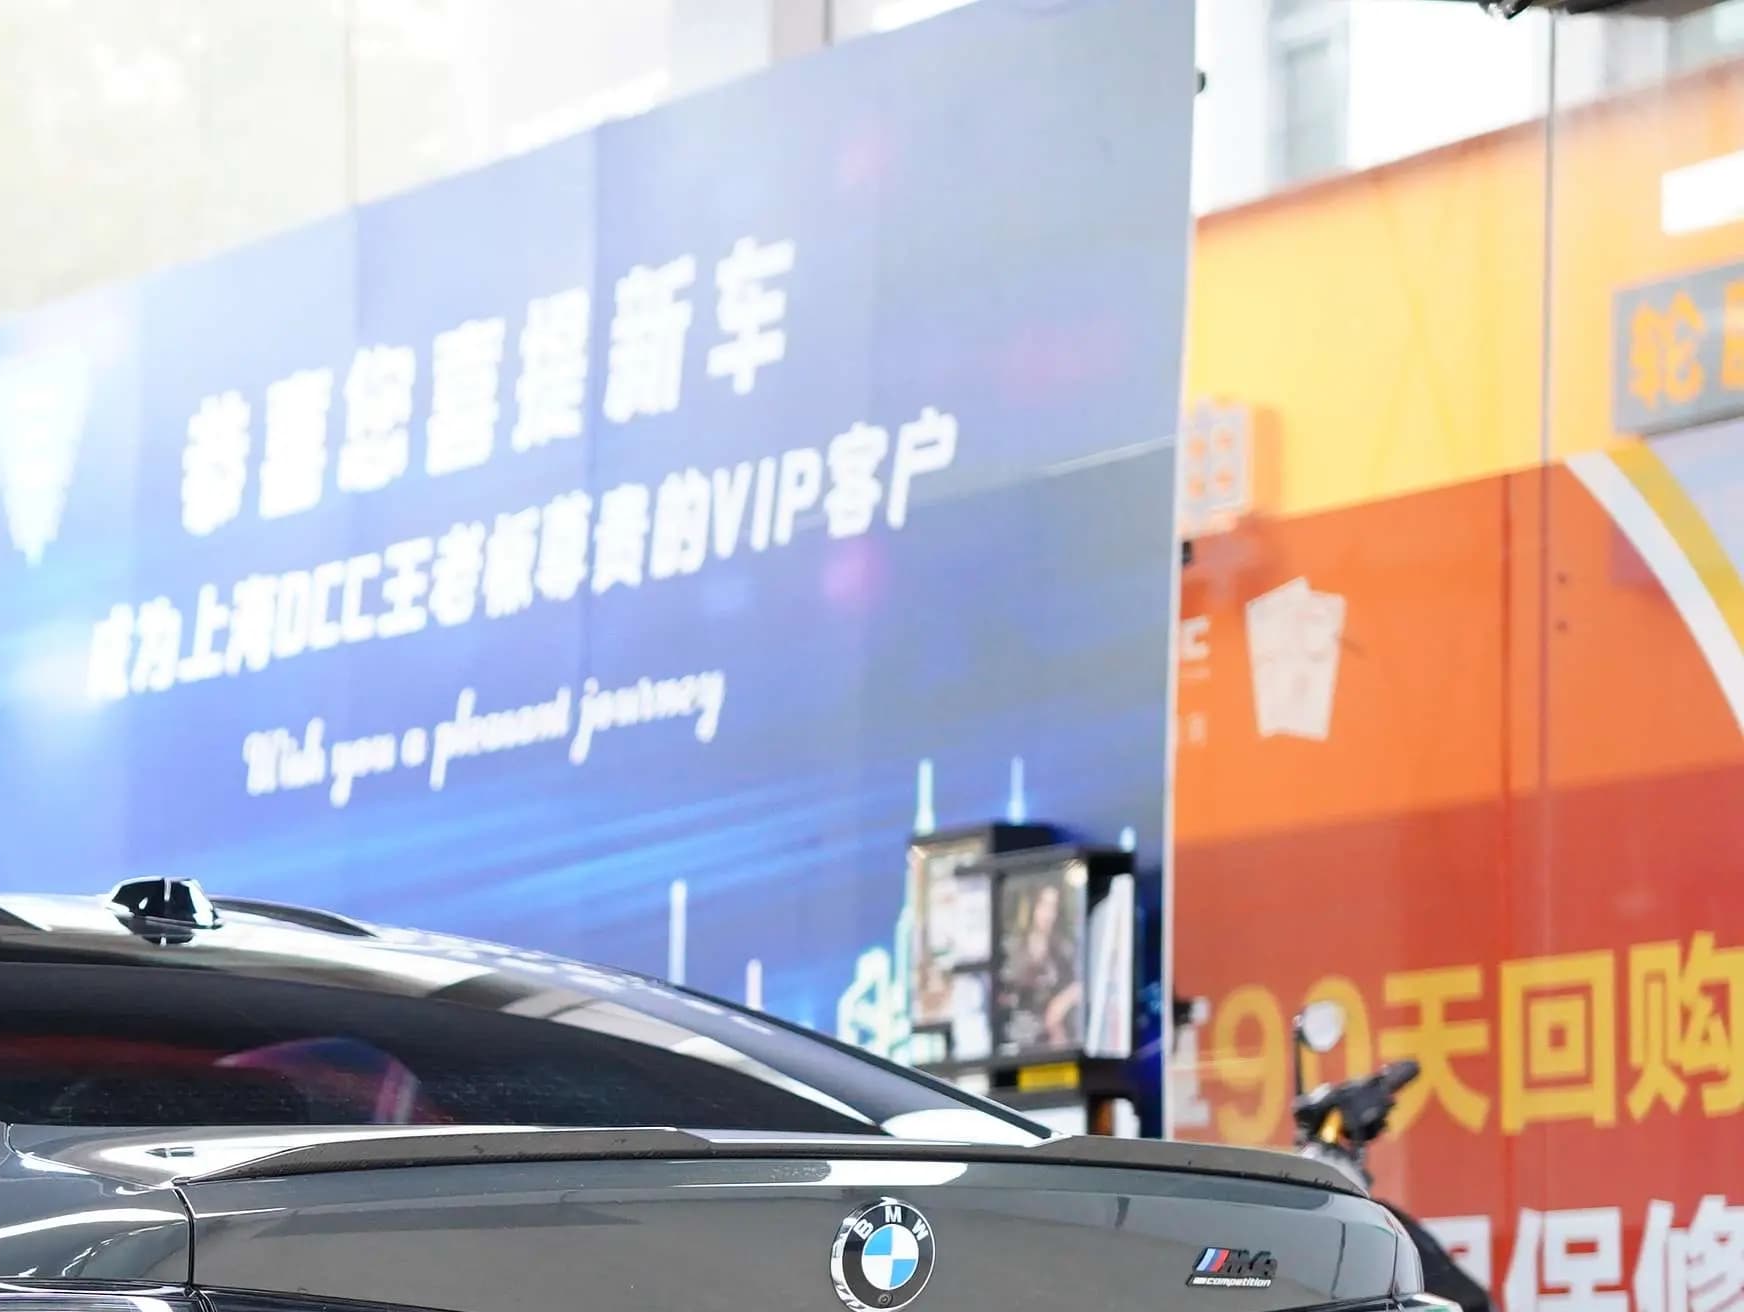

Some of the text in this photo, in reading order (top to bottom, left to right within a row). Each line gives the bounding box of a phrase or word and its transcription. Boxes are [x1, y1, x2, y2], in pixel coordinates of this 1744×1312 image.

[329, 733, 396, 809] you
[400, 727, 428, 768] a
[568, 669, 726, 767] journey
[853, 1205, 929, 1241] BMW
[1205, 1277, 1272, 1287] competition
